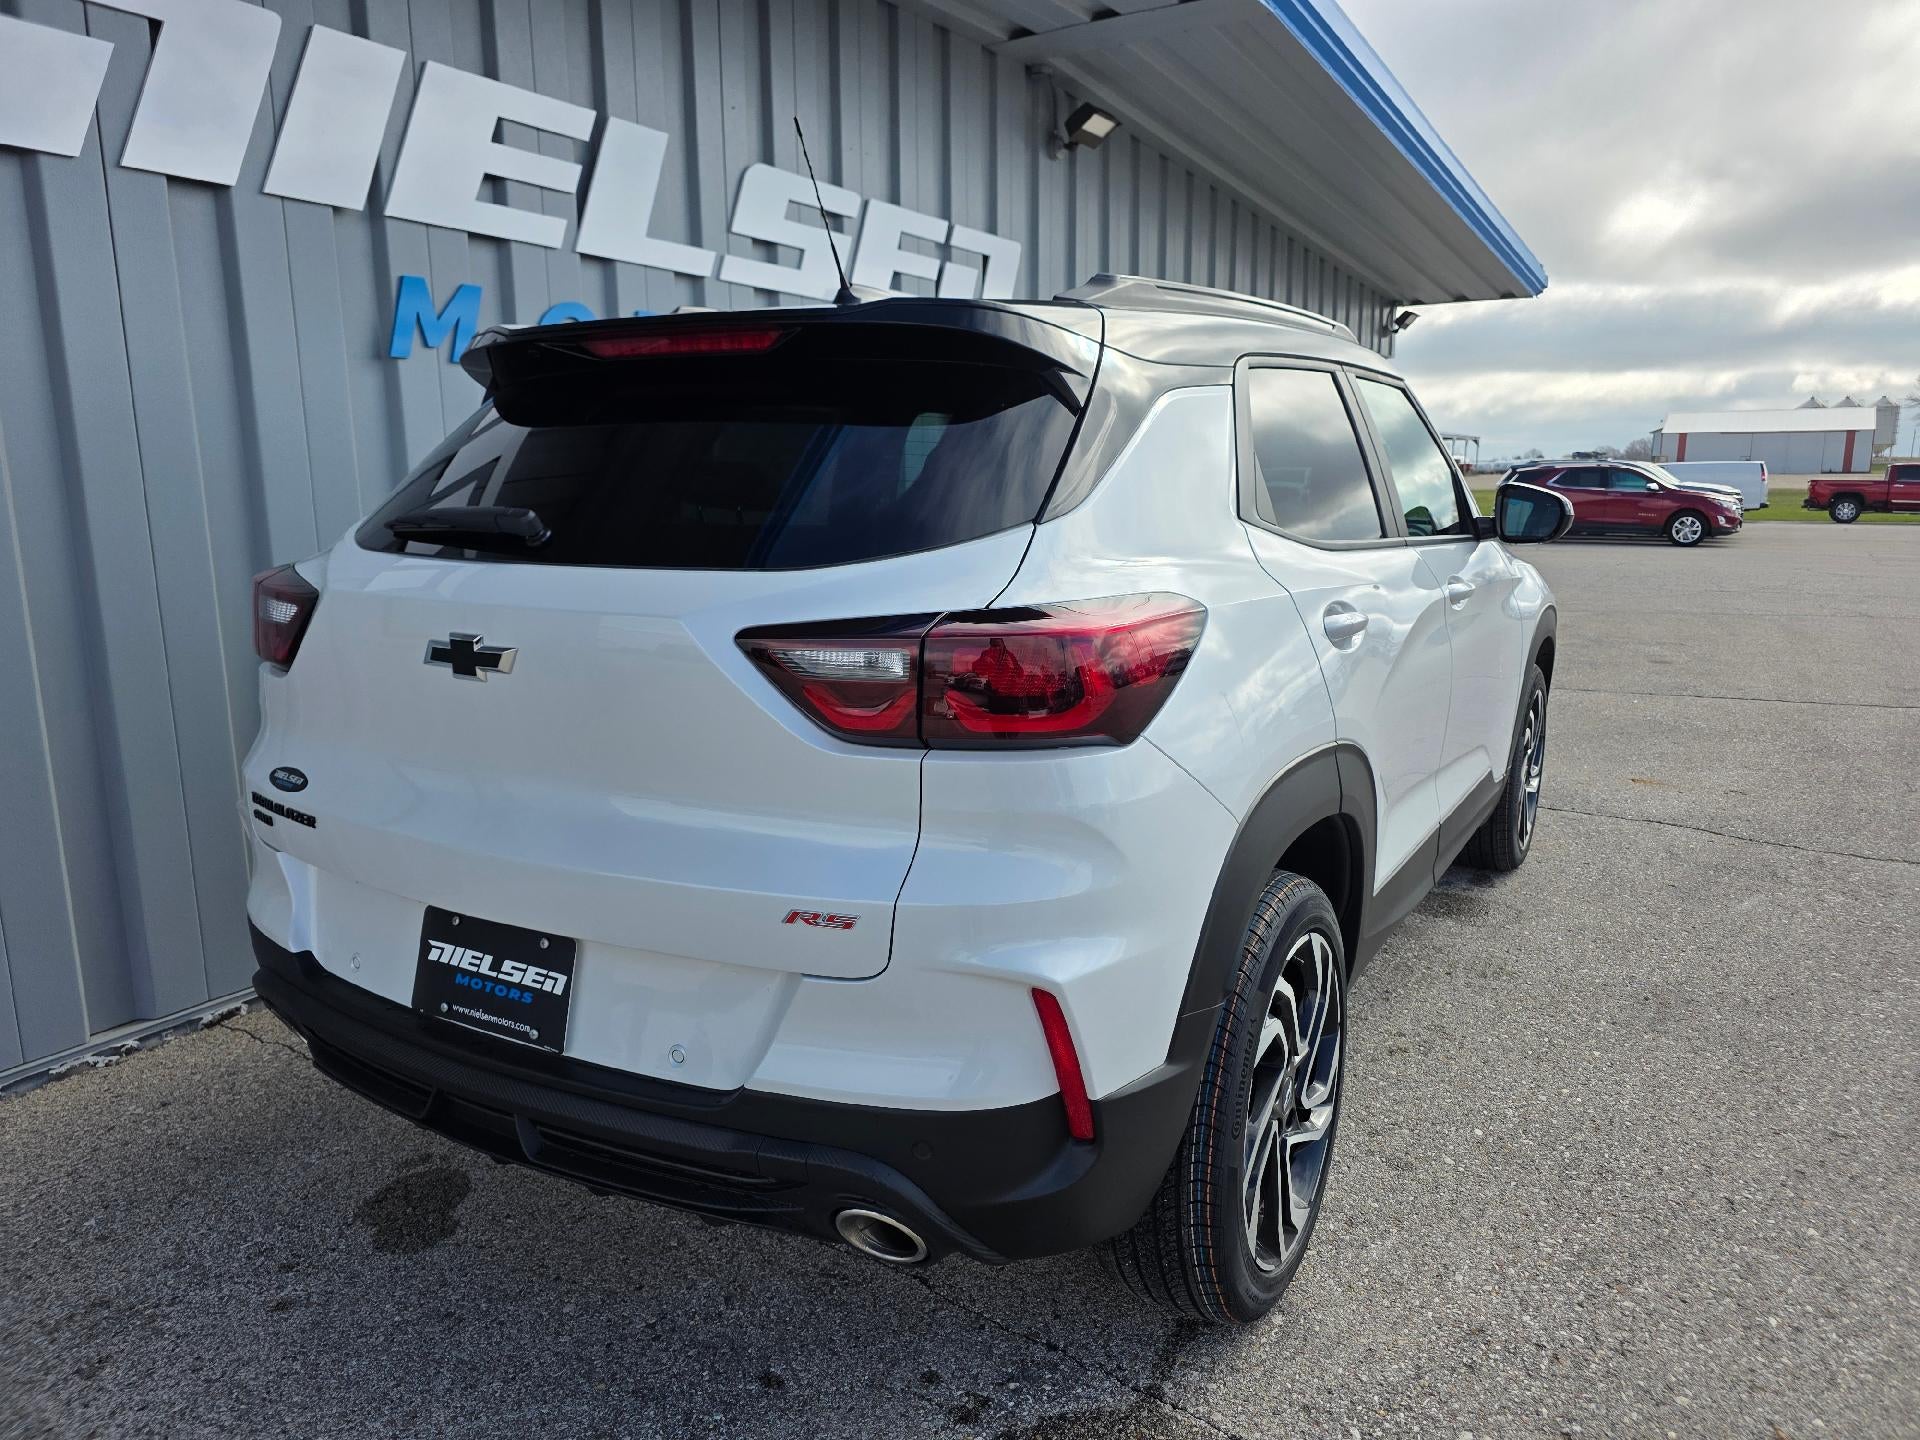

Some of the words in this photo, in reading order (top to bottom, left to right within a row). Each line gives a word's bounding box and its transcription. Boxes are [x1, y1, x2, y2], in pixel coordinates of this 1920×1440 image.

[782, 908, 861, 930] RS
[427, 939, 568, 996] NIELSEN
[455, 973, 534, 1004] MOTORS
[452, 1003, 531, 1033] www.nielsenmotors.com
